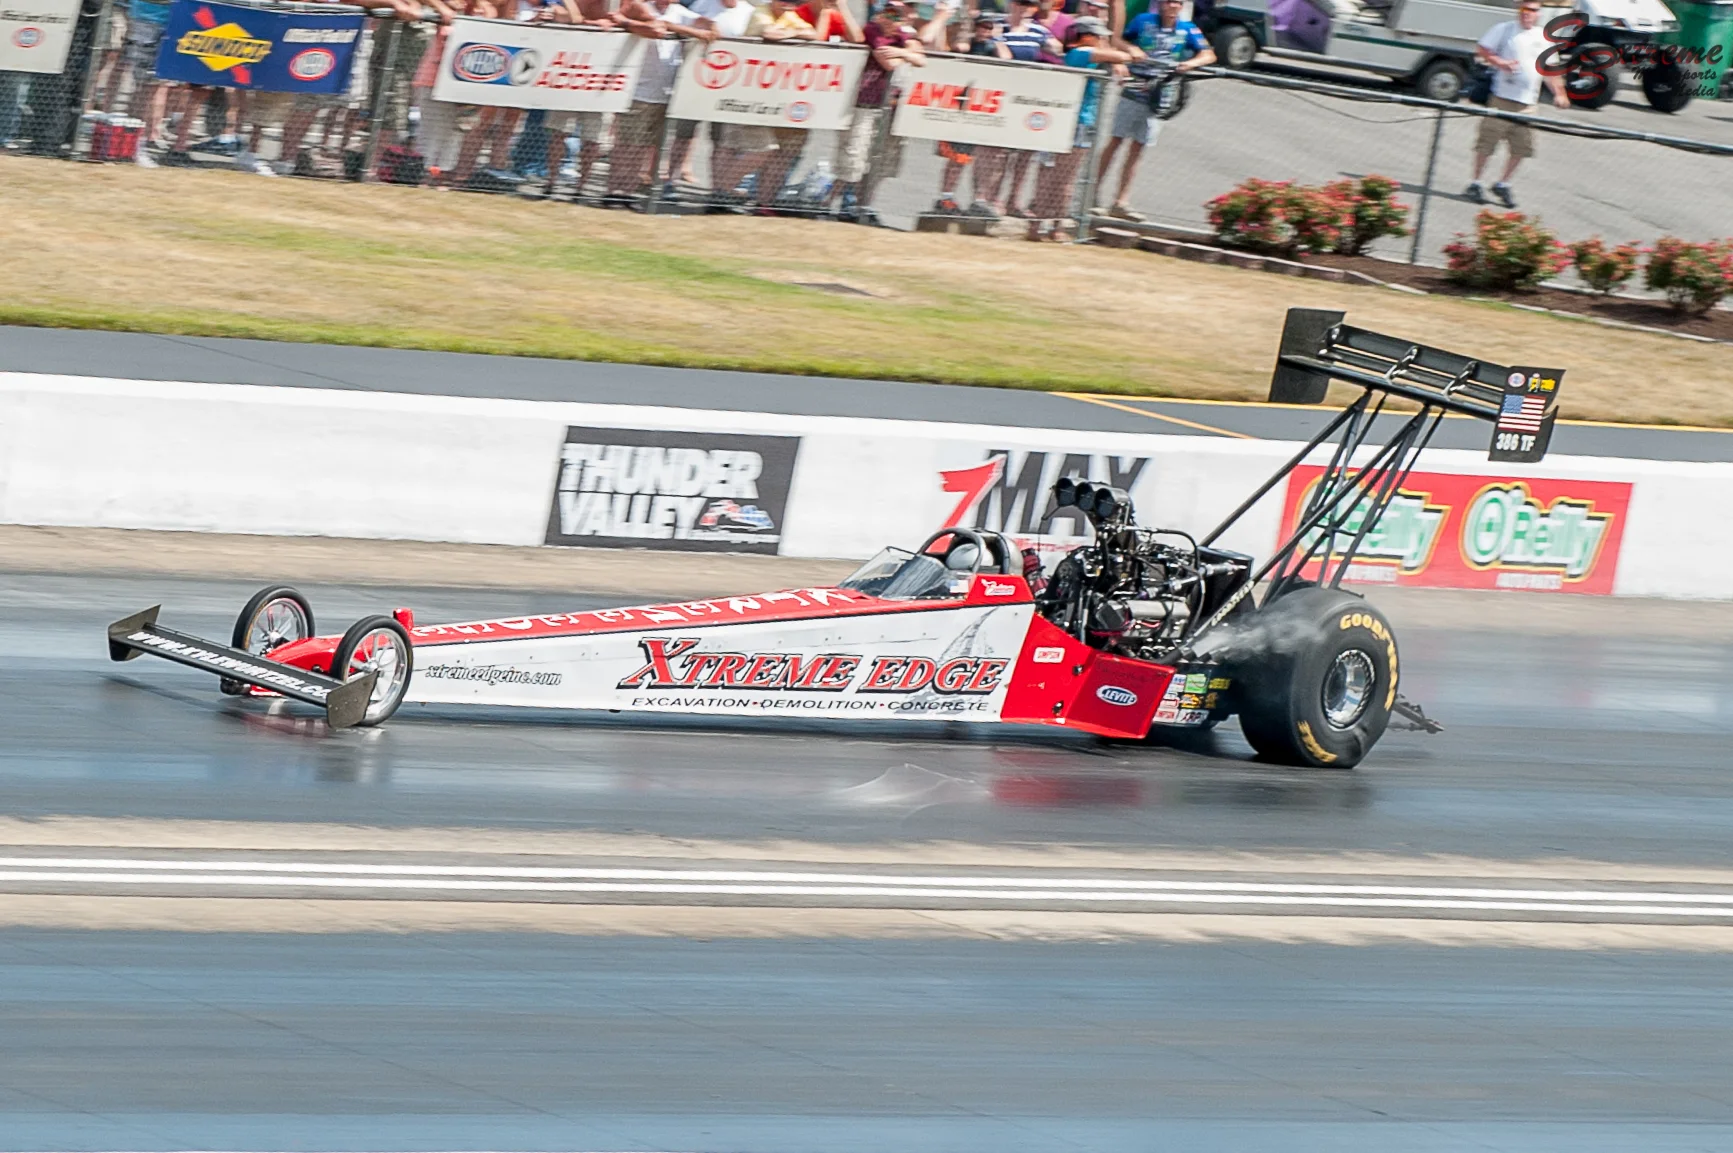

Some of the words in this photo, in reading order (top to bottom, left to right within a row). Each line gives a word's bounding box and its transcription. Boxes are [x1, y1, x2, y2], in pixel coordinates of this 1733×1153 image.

[550, 51, 593, 70] ALL
[743, 58, 845, 92] TOYOTA
[533, 71, 627, 92] ACCESS
[559, 443, 763, 499] THUNDER
[558, 491, 708, 539] VALLEY
[1299, 476, 1443, 570] OReilly
[616, 637, 863, 692] XTREME
[855, 656, 1011, 695] EDGE
[632, 697, 750, 708] EXCAVATION
[760, 698, 877, 710] DEMOLITION
[888, 701, 989, 711] CONCRETE
